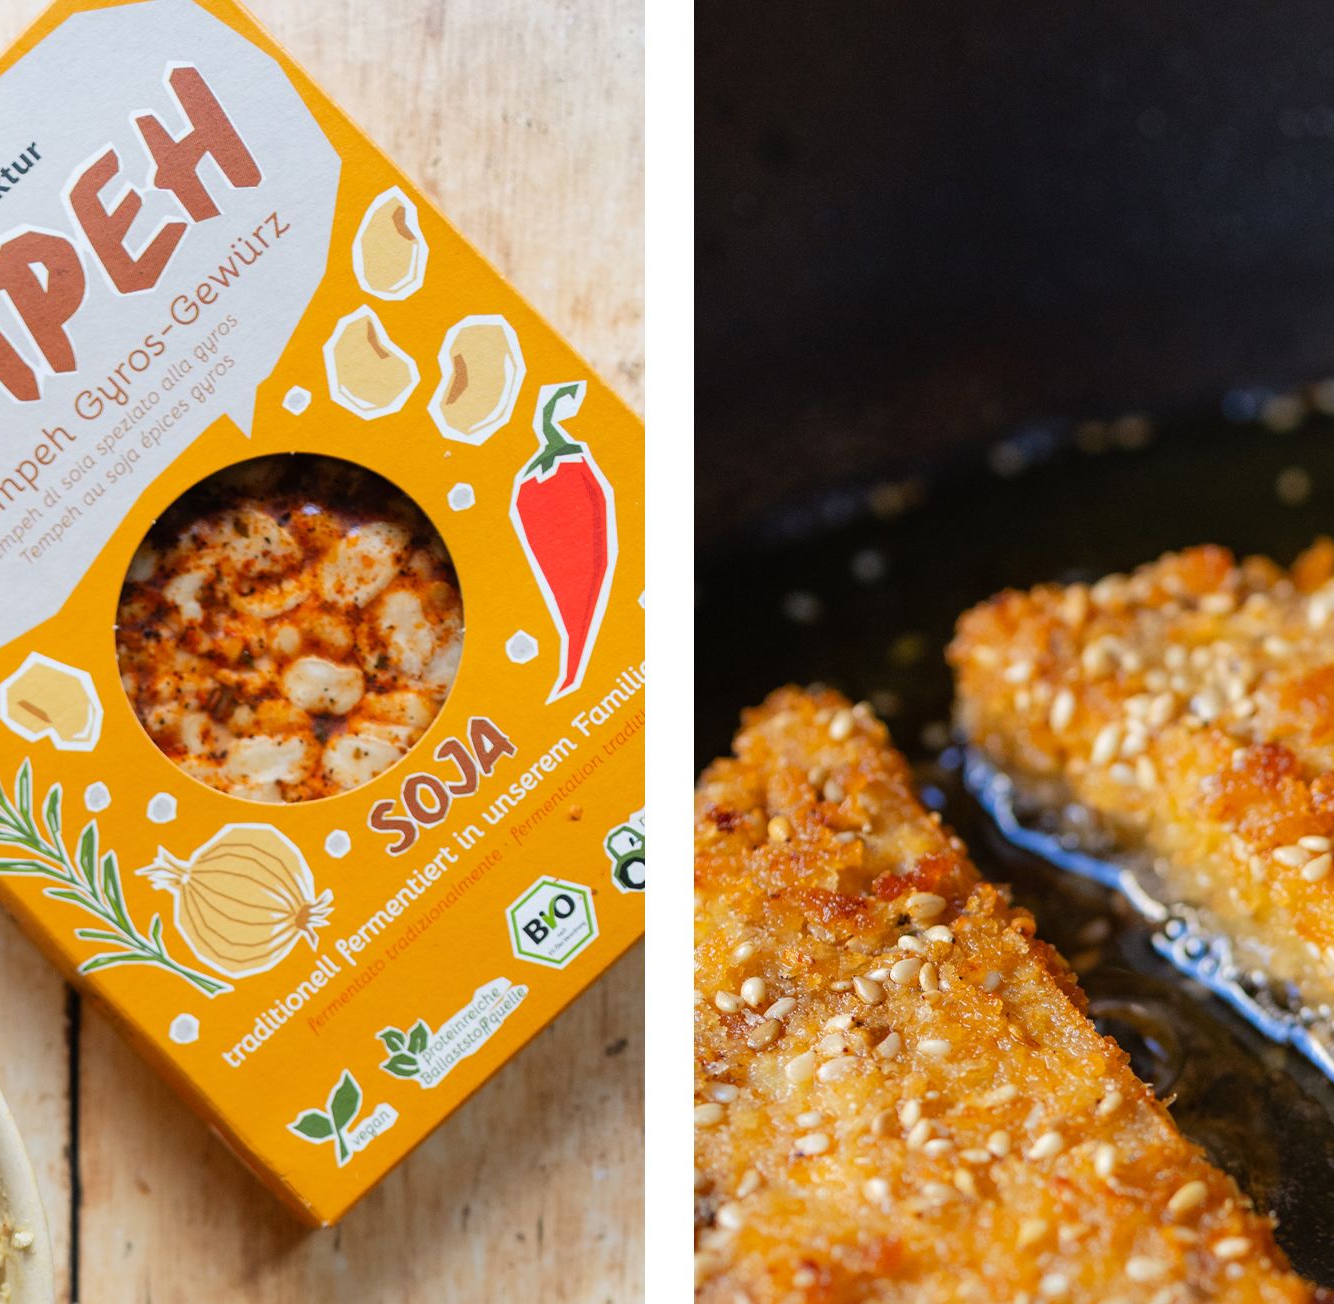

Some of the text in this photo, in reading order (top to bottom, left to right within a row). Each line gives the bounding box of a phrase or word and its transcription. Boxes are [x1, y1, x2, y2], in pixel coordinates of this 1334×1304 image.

[43, 485, 63, 508] di
[61, 453, 97, 490] soia
[96, 389, 161, 458] speziato
[160, 357, 195, 393] alla
[193, 313, 240, 363] gyros
[73, 211, 292, 422] Gyros-Gewürz
[18, 353, 236, 567] Tempeh au soja épices gyros
[369, 717, 517, 855] SOJA
[221, 953, 343, 1069] traditionell
[335, 844, 459, 966] fermentiert
[453, 822, 485, 851] in
[480, 736, 578, 827] unserem
[307, 957, 387, 1036] fermentato
[386, 849, 504, 962] tradizionalmente
[509, 756, 604, 847] fermentation
[420, 985, 527, 1085] Ballaststoffquelle
[421, 987, 501, 1066] proteinreiche
[352, 1108, 392, 1147] vegan
